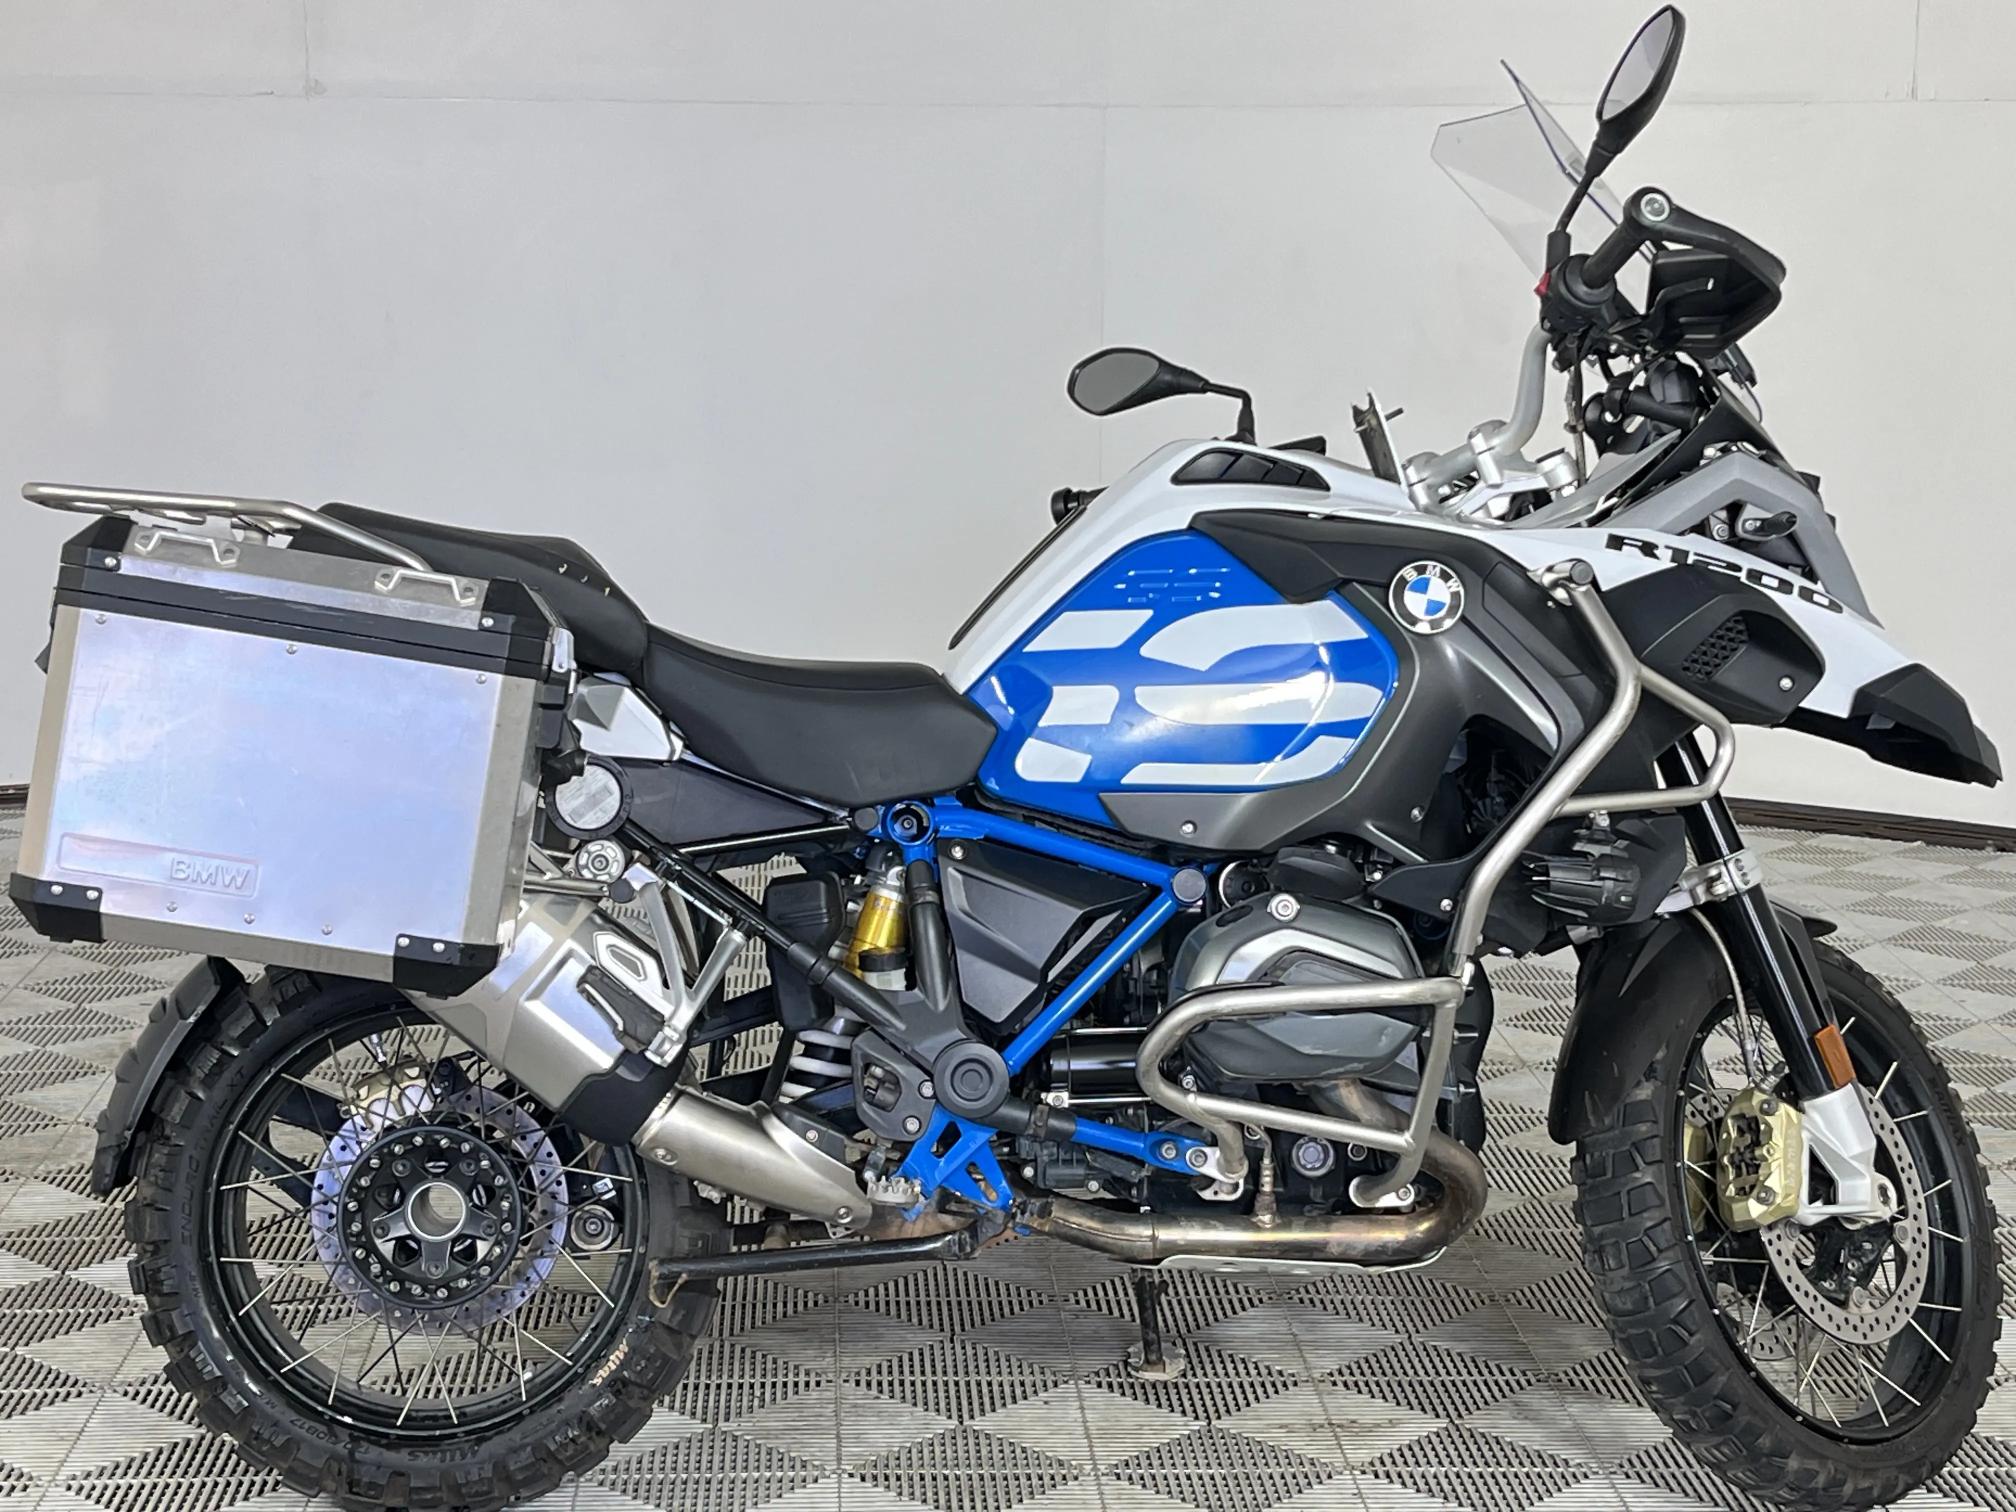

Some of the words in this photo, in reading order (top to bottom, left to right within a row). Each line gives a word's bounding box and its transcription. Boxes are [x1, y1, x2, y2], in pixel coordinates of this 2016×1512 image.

[1402, 564, 1461, 593] BMW
[1605, 533, 1844, 615] R1200
[170, 857, 250, 890] BMW
